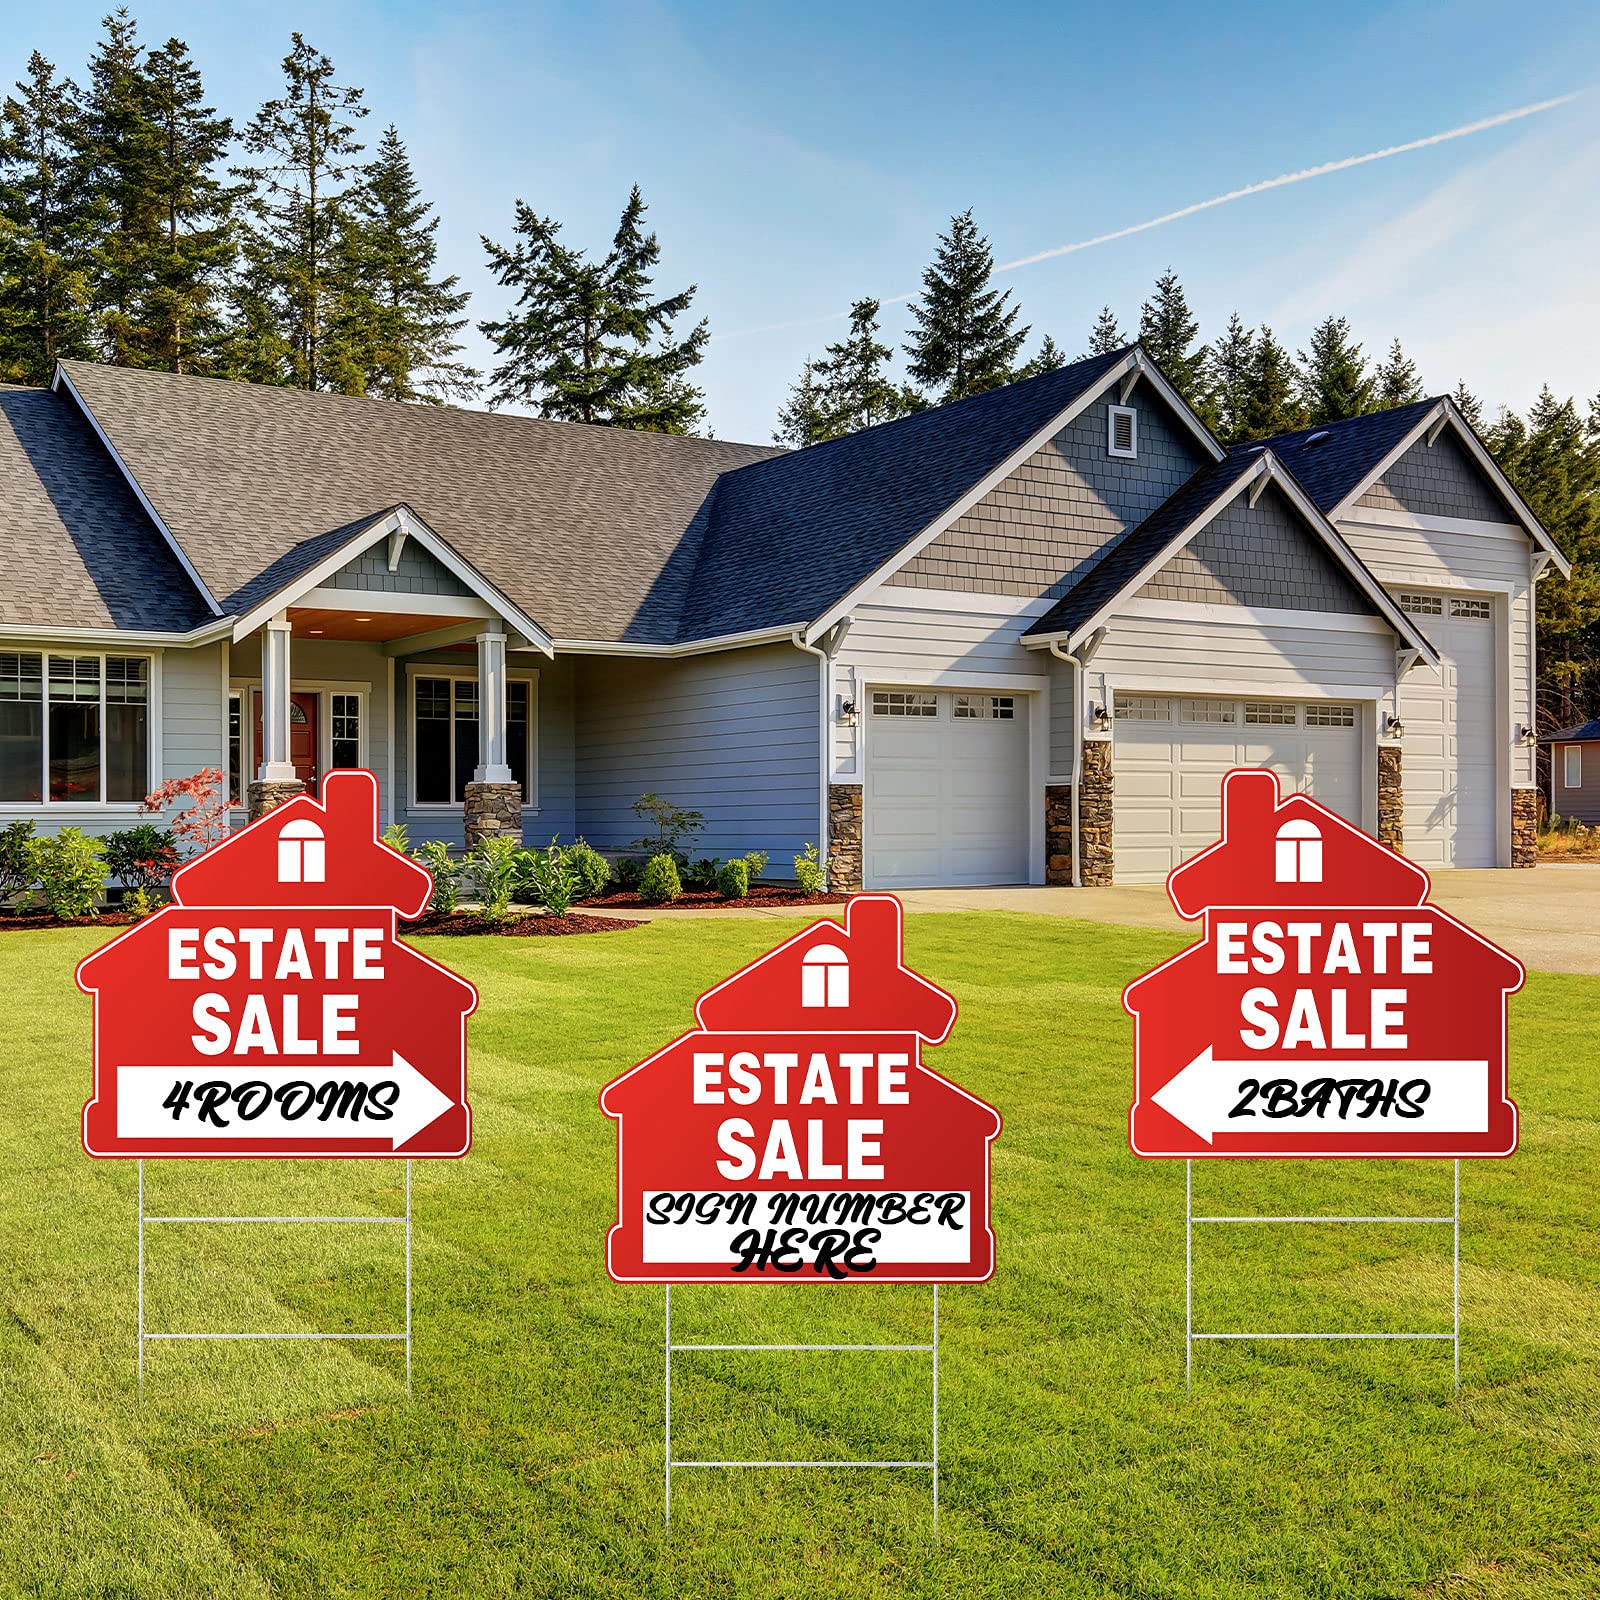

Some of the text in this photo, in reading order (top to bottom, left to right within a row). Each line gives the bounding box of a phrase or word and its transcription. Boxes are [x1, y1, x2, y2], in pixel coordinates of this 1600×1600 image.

[168, 926, 385, 980] ESTATE
[1216, 921, 1433, 975] ESTATE
[191, 992, 360, 1056] SALE
[1239, 987, 1408, 1051] SALE
[692, 1051, 910, 1105] ESTATE
[716, 1117, 885, 1181] SALE
[646, 1192, 966, 1231] SIGN NUMBER
[729, 1227, 882, 1280] HERE
